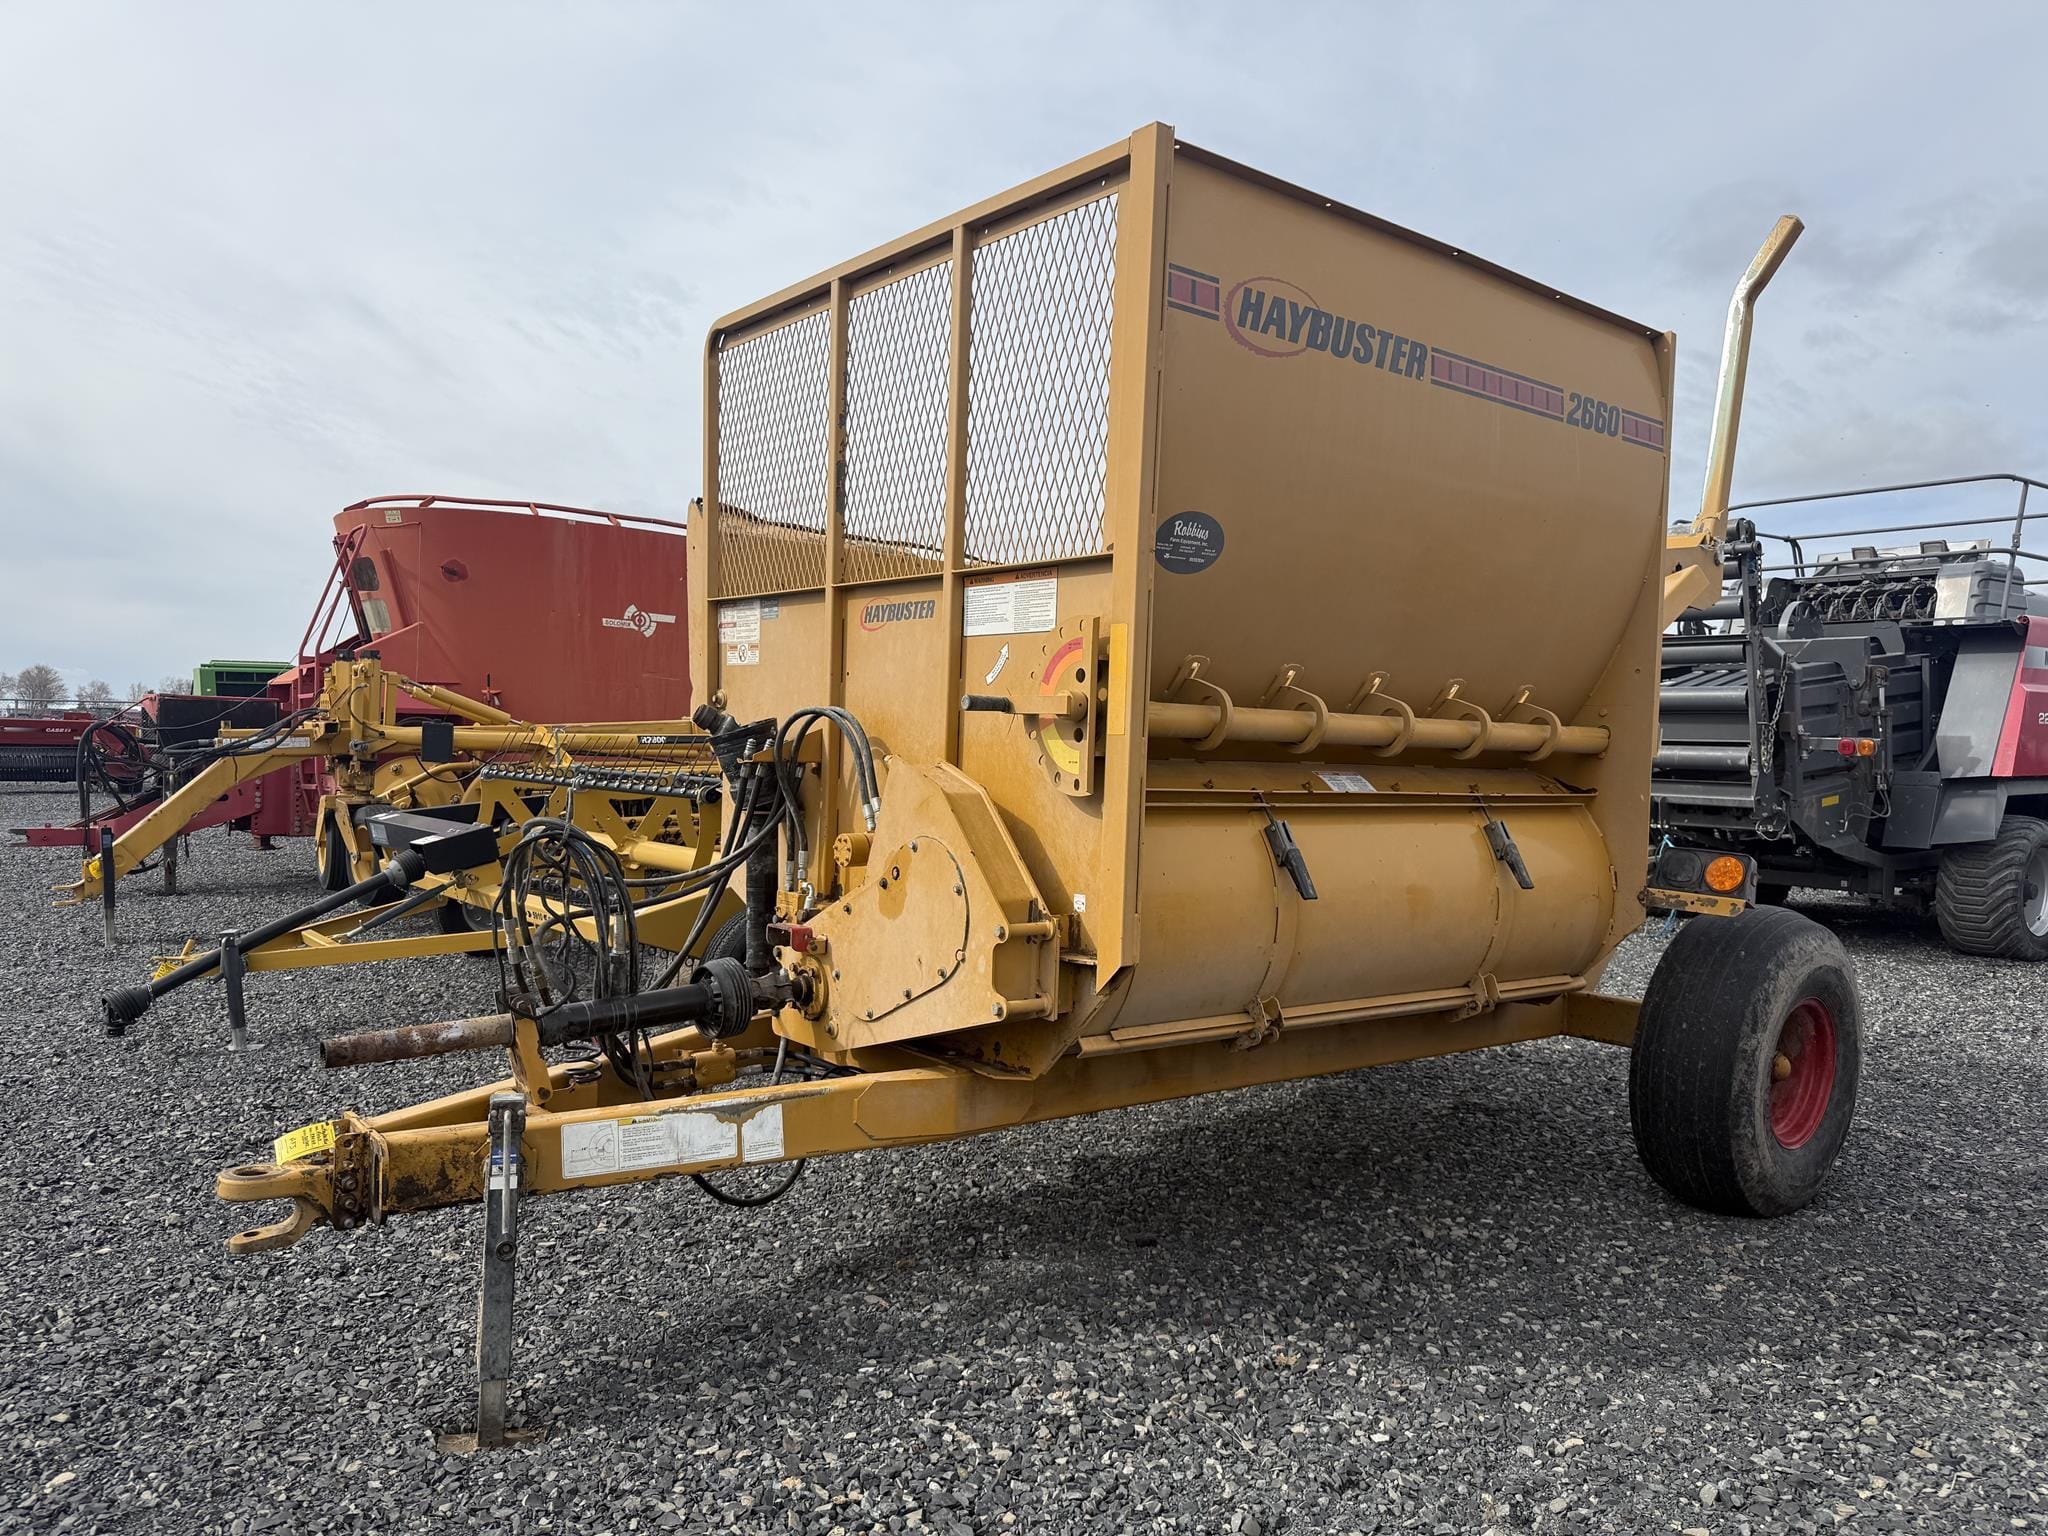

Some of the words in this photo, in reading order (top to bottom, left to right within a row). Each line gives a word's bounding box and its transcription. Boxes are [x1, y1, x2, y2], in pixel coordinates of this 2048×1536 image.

[1237, 287, 1428, 381] HAYBUSTER
[1566, 392, 1620, 437] 2660
[1174, 520, 1209, 540] Robbins
[605, 619, 631, 627] SOLOMIX
[864, 600, 936, 624] HAYBUSTER
